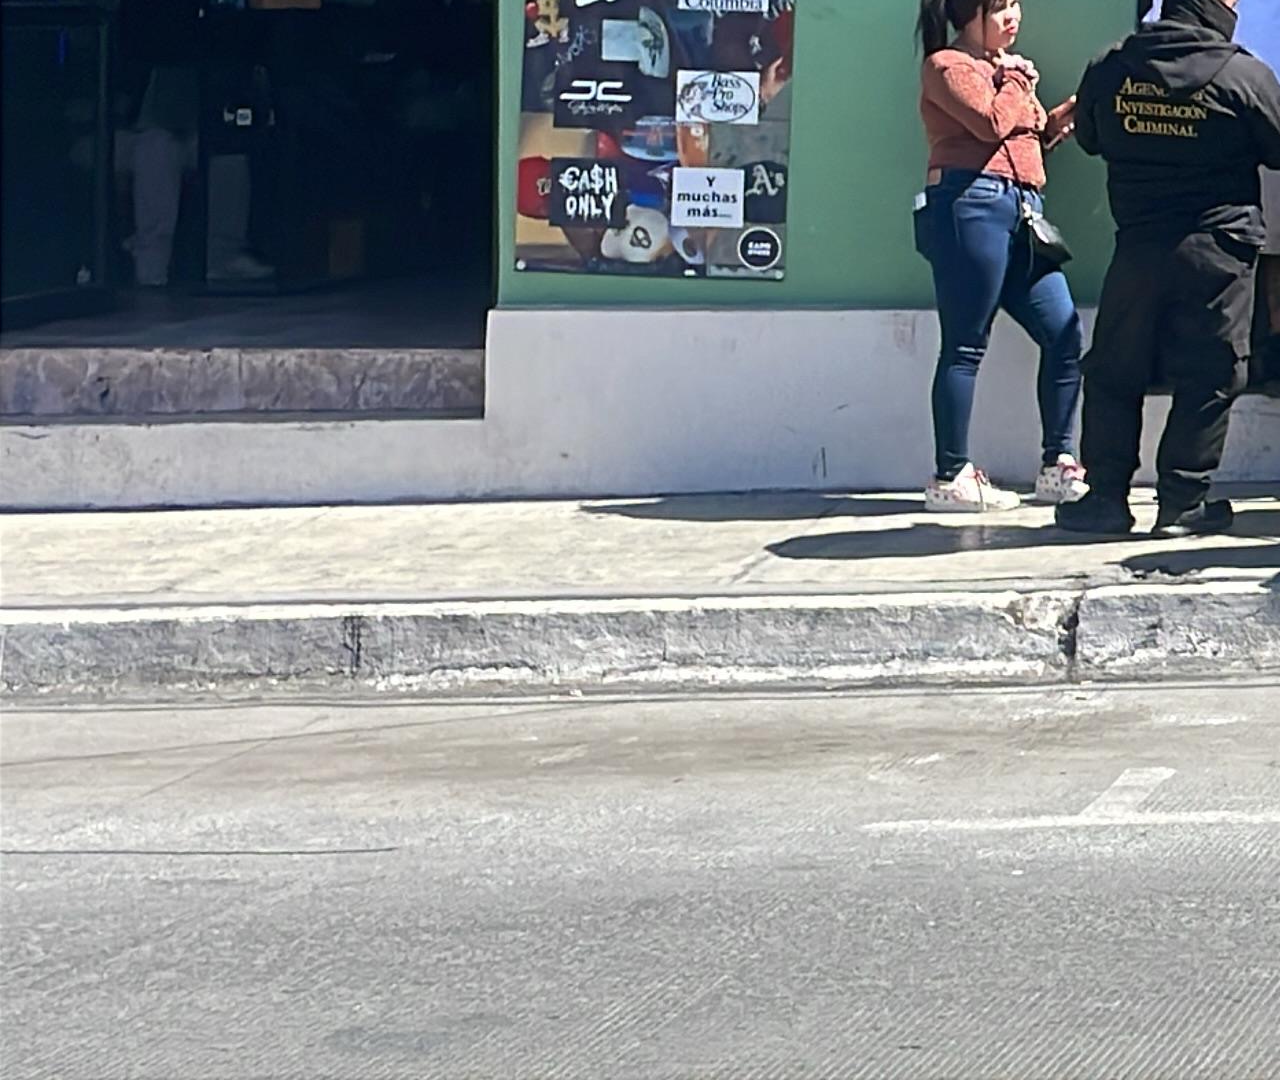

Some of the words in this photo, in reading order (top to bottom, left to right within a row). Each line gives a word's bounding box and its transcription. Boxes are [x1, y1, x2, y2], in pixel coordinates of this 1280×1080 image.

[711, 73, 742, 89] Bass
[709, 87, 734, 101] Pro
[706, 176, 716, 187] Y
[677, 192, 738, 204] muchas
[565, 192, 615, 222] ONLY
